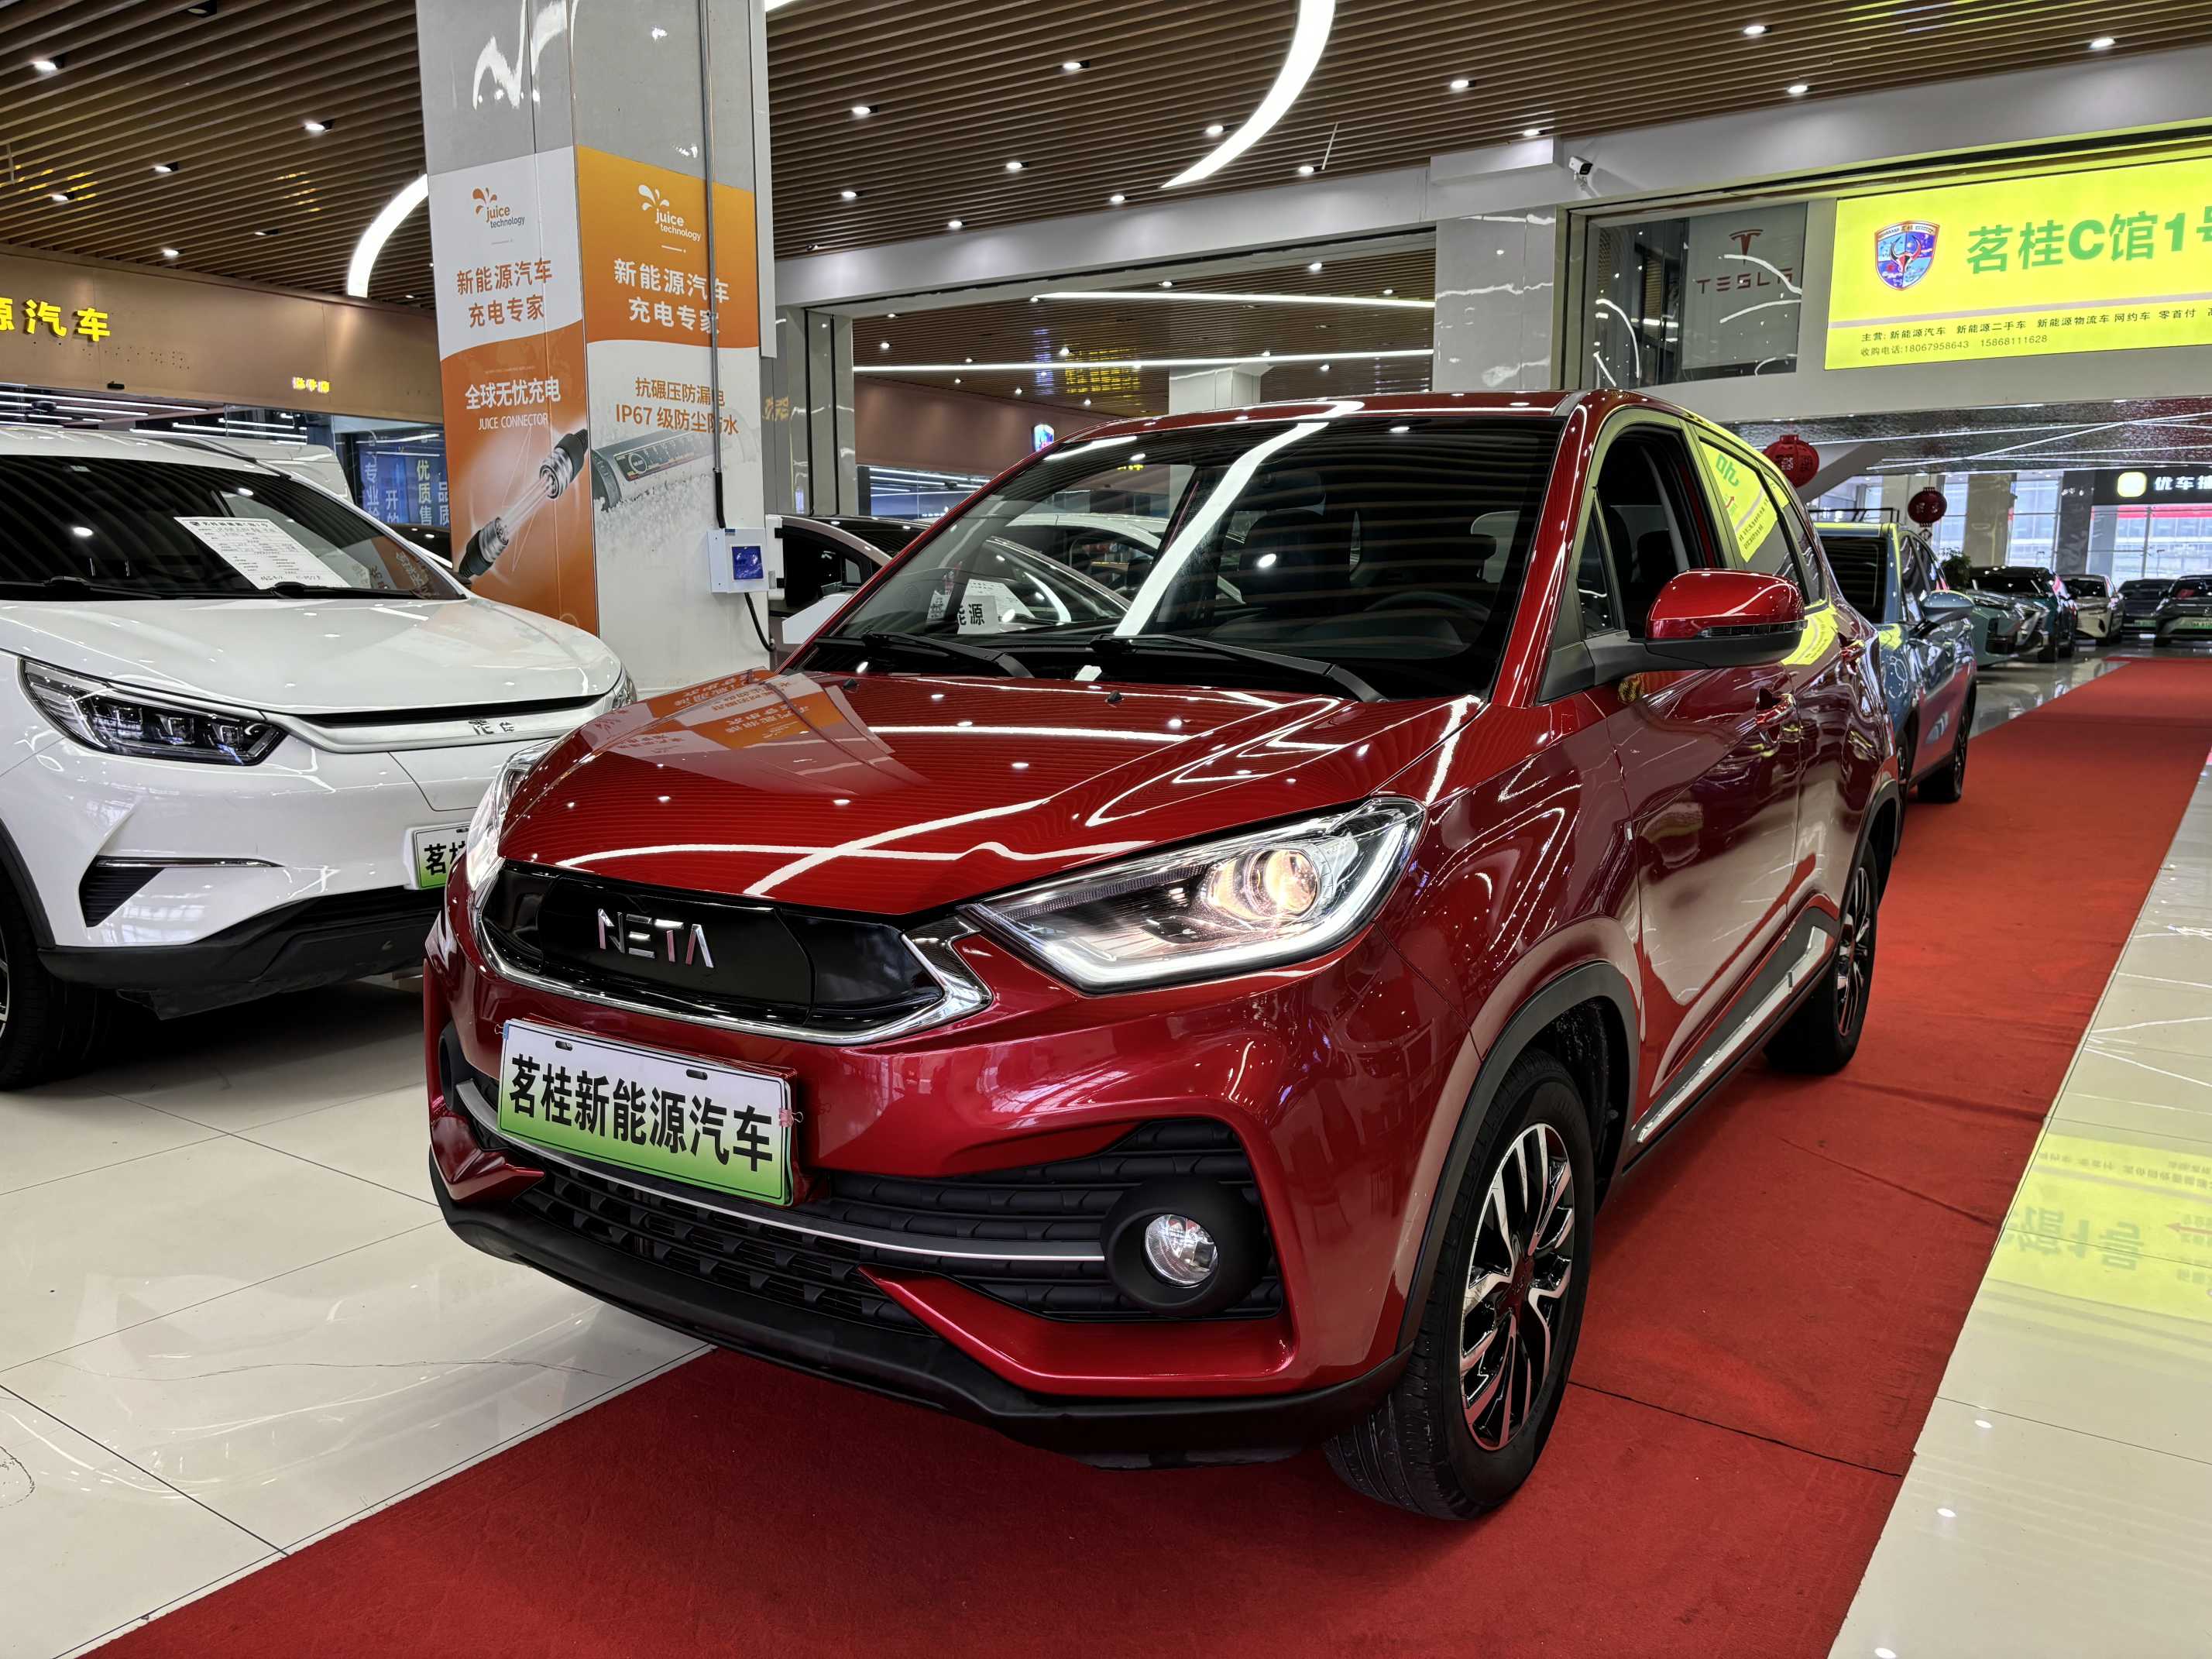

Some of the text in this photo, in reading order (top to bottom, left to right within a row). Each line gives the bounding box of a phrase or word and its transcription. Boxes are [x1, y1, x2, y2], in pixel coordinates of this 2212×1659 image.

[486, 205, 510, 223] juice
[490, 217, 525, 228] technology
[655, 208, 685, 226] juice
[661, 223, 701, 242] technology
[457, 257, 552, 295] 新能源汽车
[614, 258, 730, 304] 新能源汽车
[1696, 267, 1793, 294] TESLA
[469, 294, 544, 328] 充电专家
[628, 297, 720, 335] 充电专家
[1956, 321, 2027, 334] 新能源二手车
[2037, 314, 2110, 328] 新能源物流车
[2114, 311, 2151, 323] 网约车
[2159, 307, 2197, 319] 零首付
[1980, 335, 2048, 348] 15868111628
[465, 376, 562, 410] 全球无忧充电
[635, 376, 726, 407] 抗碾压防漏电
[479, 412, 549, 431] JUICE CONNECTOR
[616, 404, 652, 425] IP67
[657, 407, 740, 435] 级防尘防水
[596, 908, 715, 968] NETA
[509, 1053, 774, 1173] 茗桂新能源汽车
